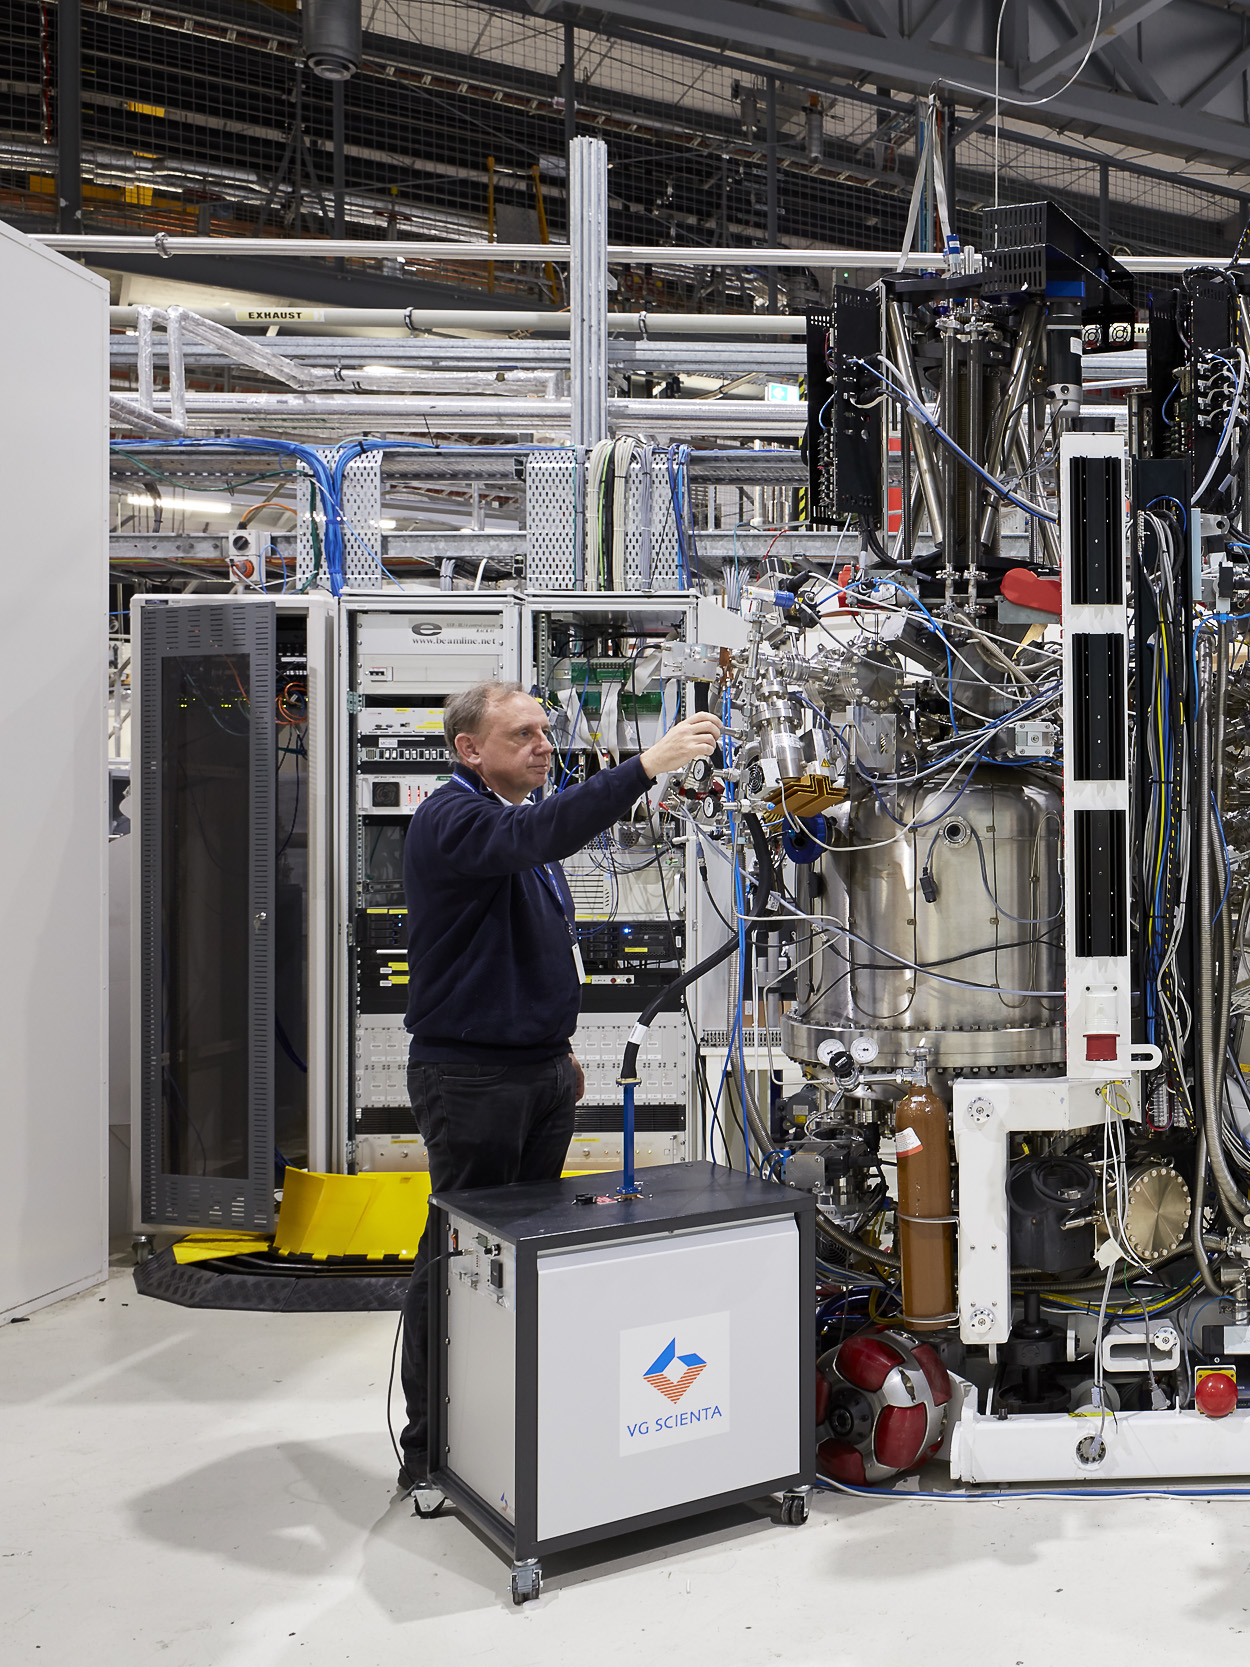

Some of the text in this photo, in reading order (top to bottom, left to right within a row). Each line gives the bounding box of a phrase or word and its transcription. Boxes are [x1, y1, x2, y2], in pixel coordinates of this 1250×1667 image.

[248, 311, 302, 320] EXHAUST
[412, 637, 496, 645] www.beamline.net
[626, 1405, 723, 1437] VG SCIENTA
